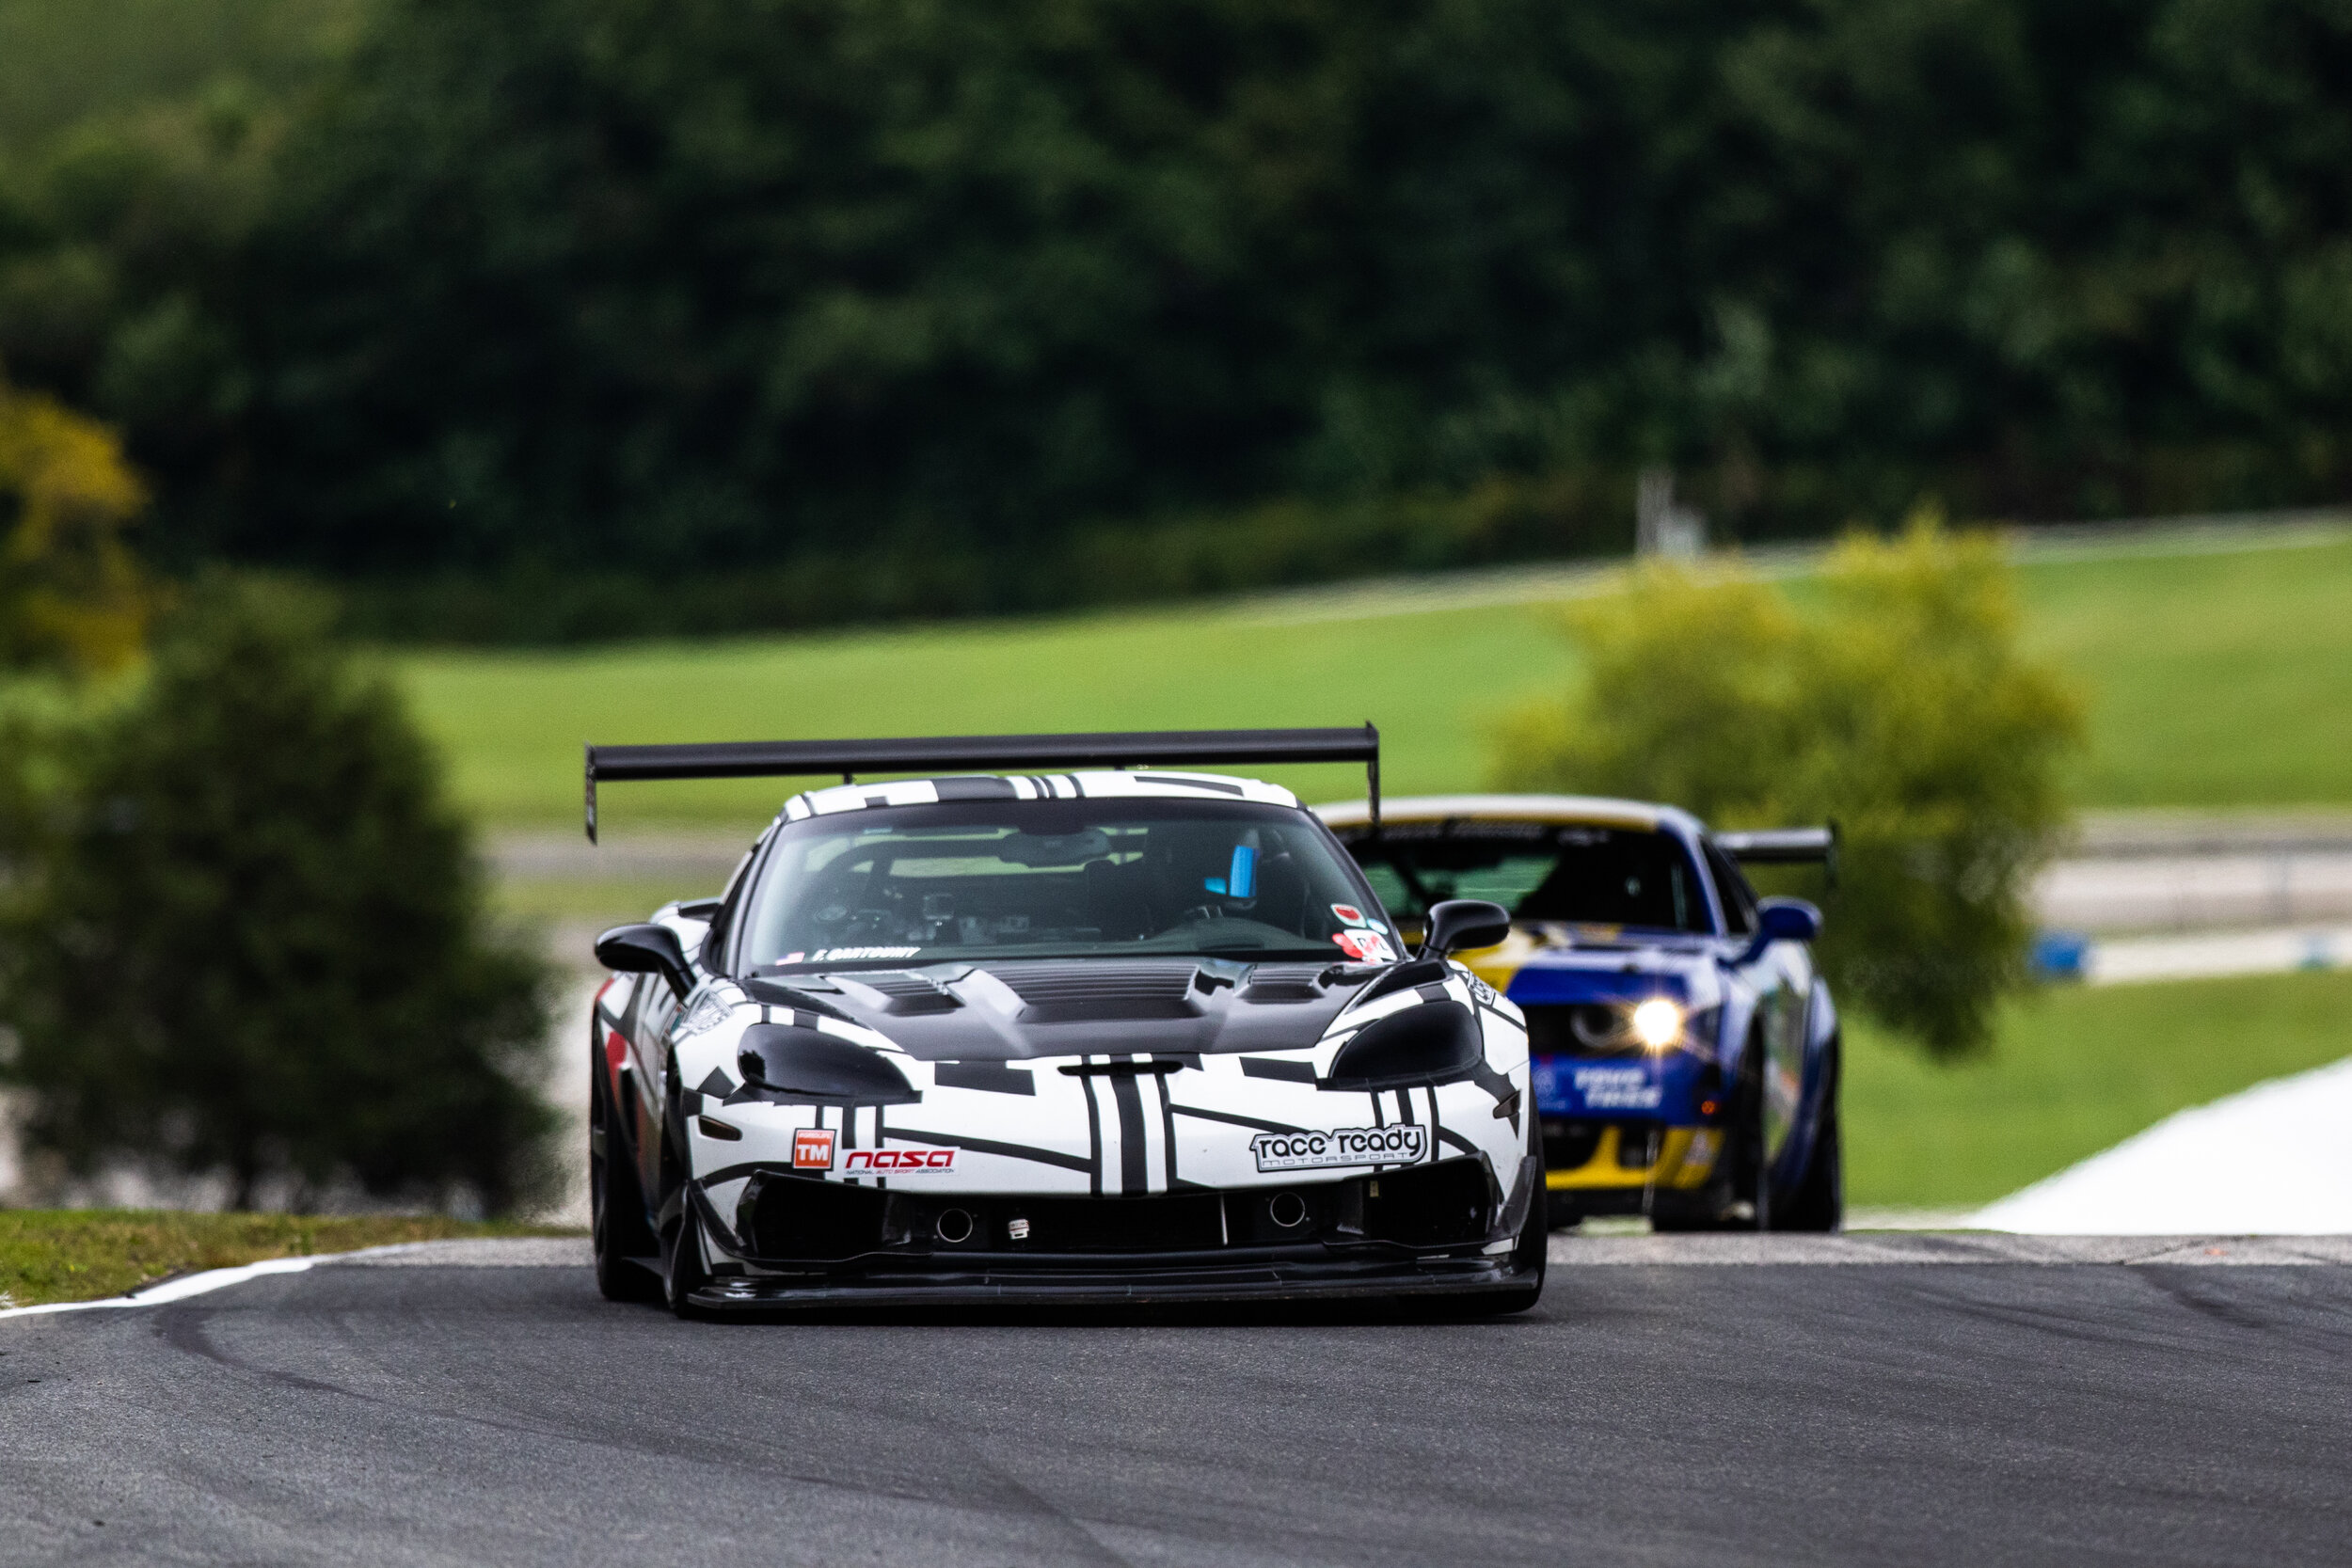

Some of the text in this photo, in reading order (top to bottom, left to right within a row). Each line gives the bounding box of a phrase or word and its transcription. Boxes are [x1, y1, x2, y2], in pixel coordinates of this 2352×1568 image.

[797, 1144, 830, 1161] TM
[1259, 1129, 1420, 1159] race ready
